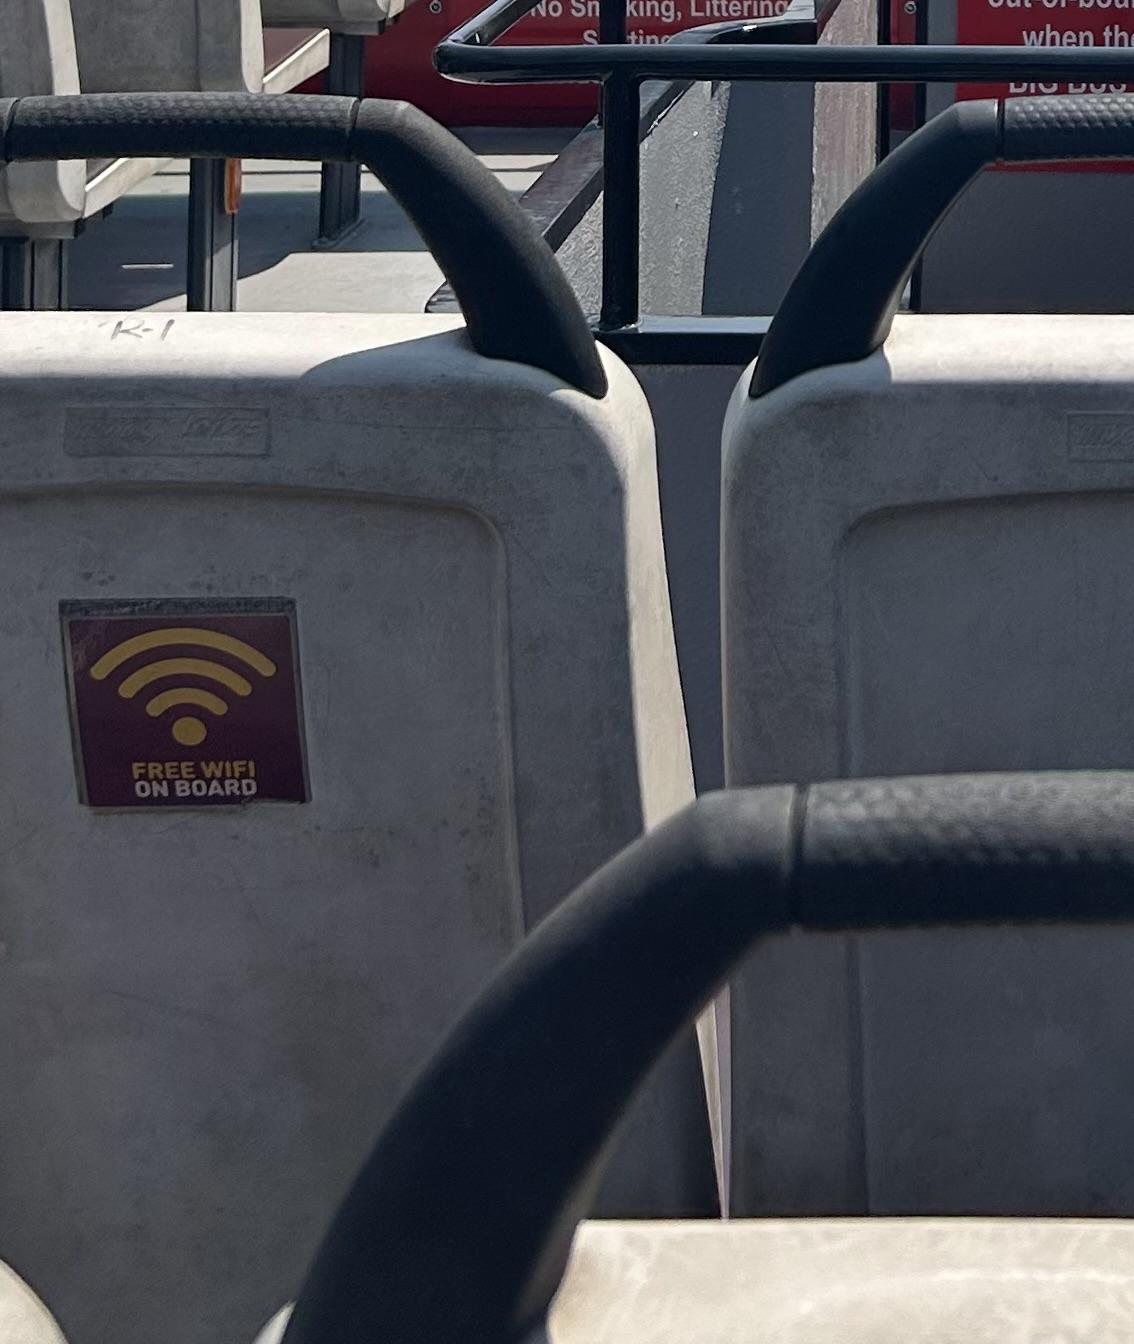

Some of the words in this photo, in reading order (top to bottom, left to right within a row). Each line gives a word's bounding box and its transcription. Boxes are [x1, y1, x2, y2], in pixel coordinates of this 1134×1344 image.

[1022, 24, 1094, 47] when
[132, 761, 195, 779] FREE
[201, 760, 256, 779] WIFI
[135, 780, 169, 797] ON
[175, 779, 257, 797] BOARD
